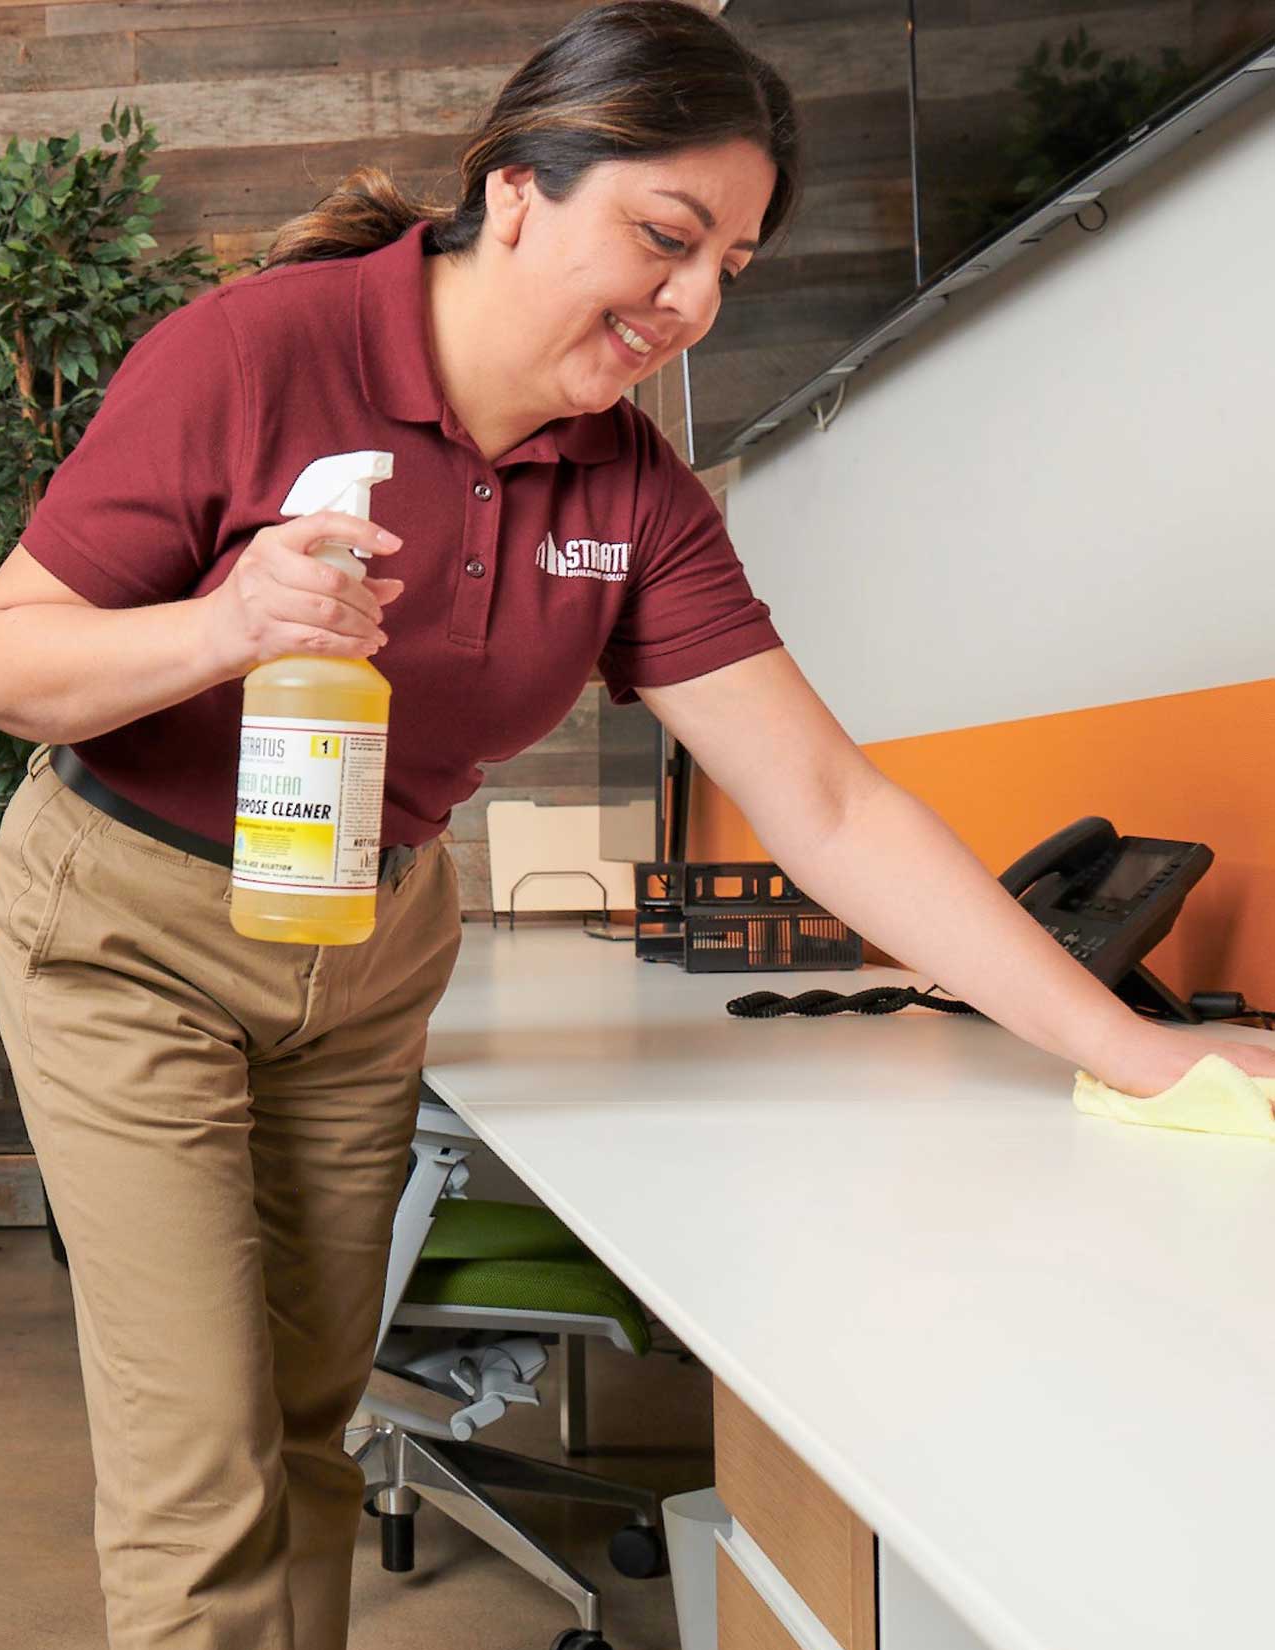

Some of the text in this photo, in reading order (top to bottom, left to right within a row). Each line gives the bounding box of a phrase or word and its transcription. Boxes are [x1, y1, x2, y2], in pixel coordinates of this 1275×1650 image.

[566, 539, 632, 572] STRATU
[322, 740, 329, 754] 1
[260, 774, 302, 796] CLEAN
[272, 801, 332, 820] CLEANER
